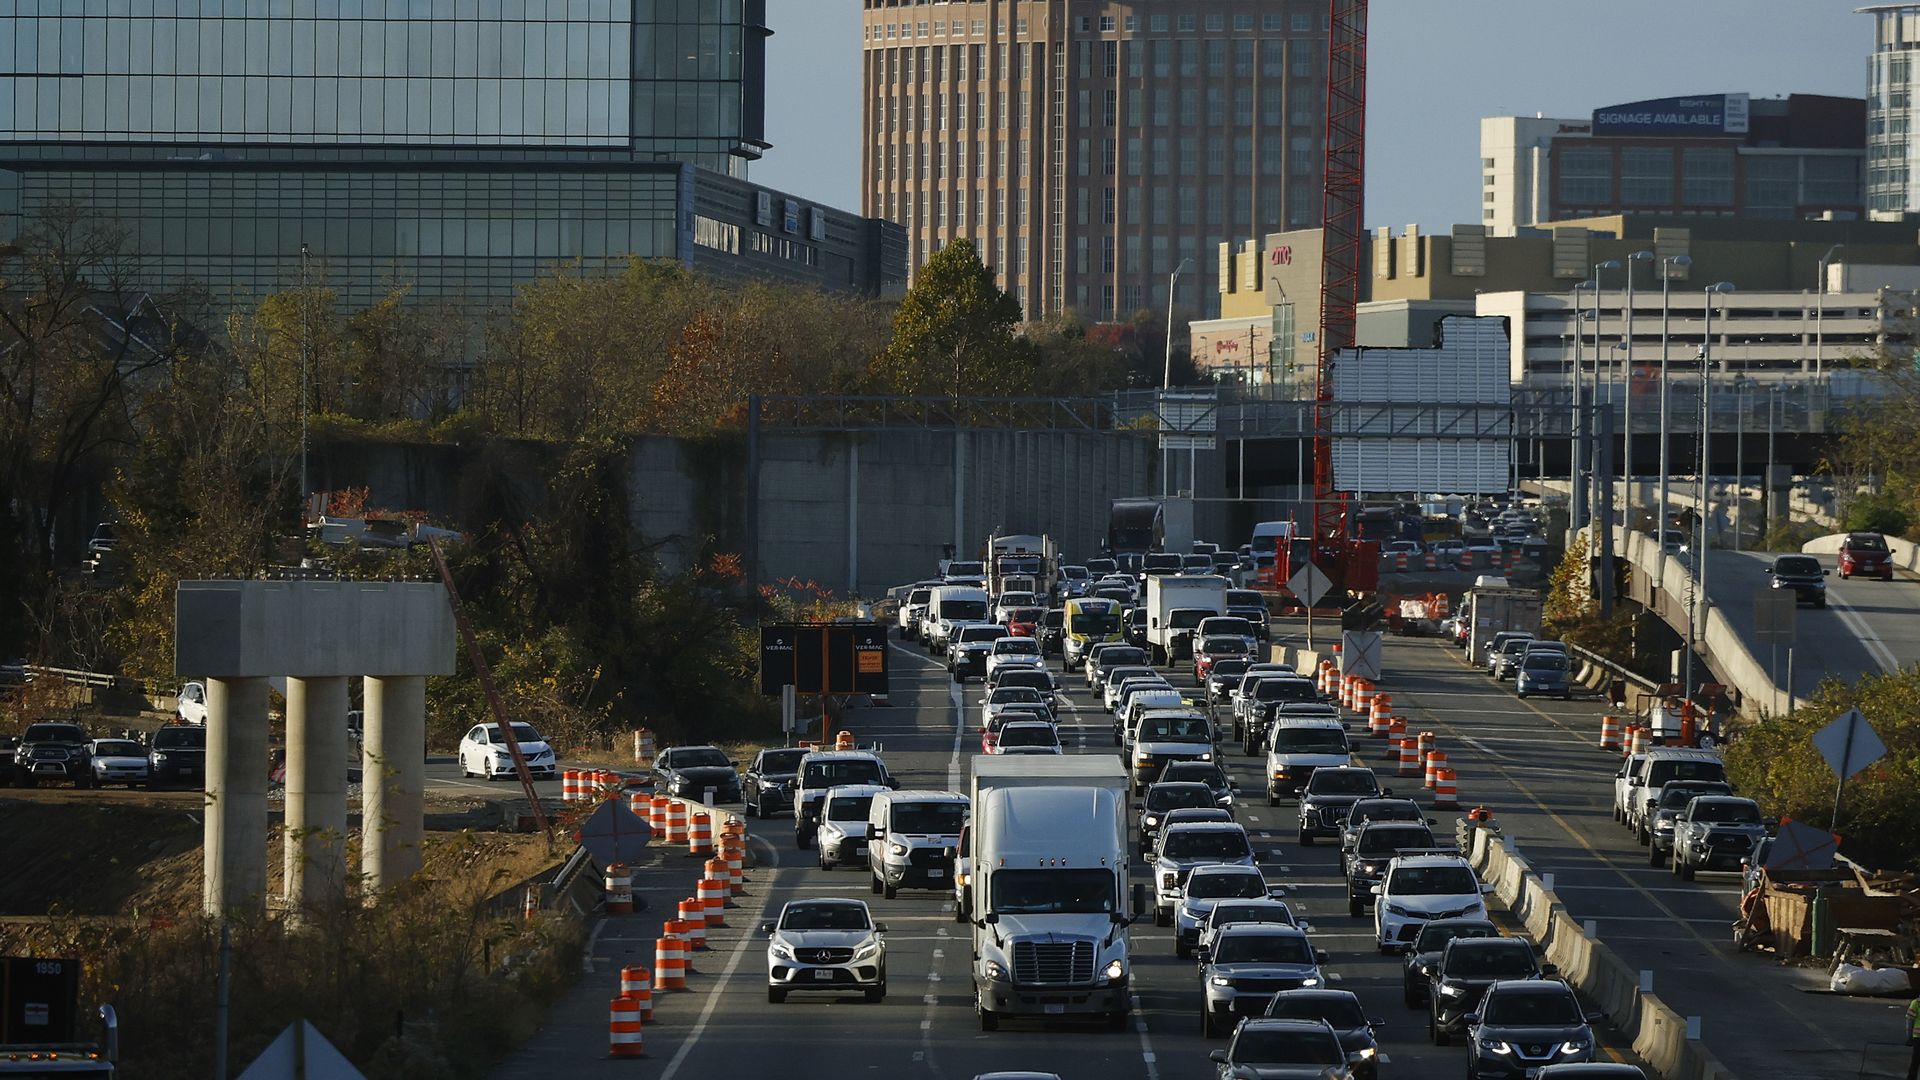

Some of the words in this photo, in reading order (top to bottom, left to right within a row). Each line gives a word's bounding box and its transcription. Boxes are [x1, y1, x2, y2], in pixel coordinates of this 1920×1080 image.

[1598, 113, 1652, 124] SIGNAGE
[1653, 113, 1721, 125] AVAILABLE
[35, 962, 62, 974] 1950
